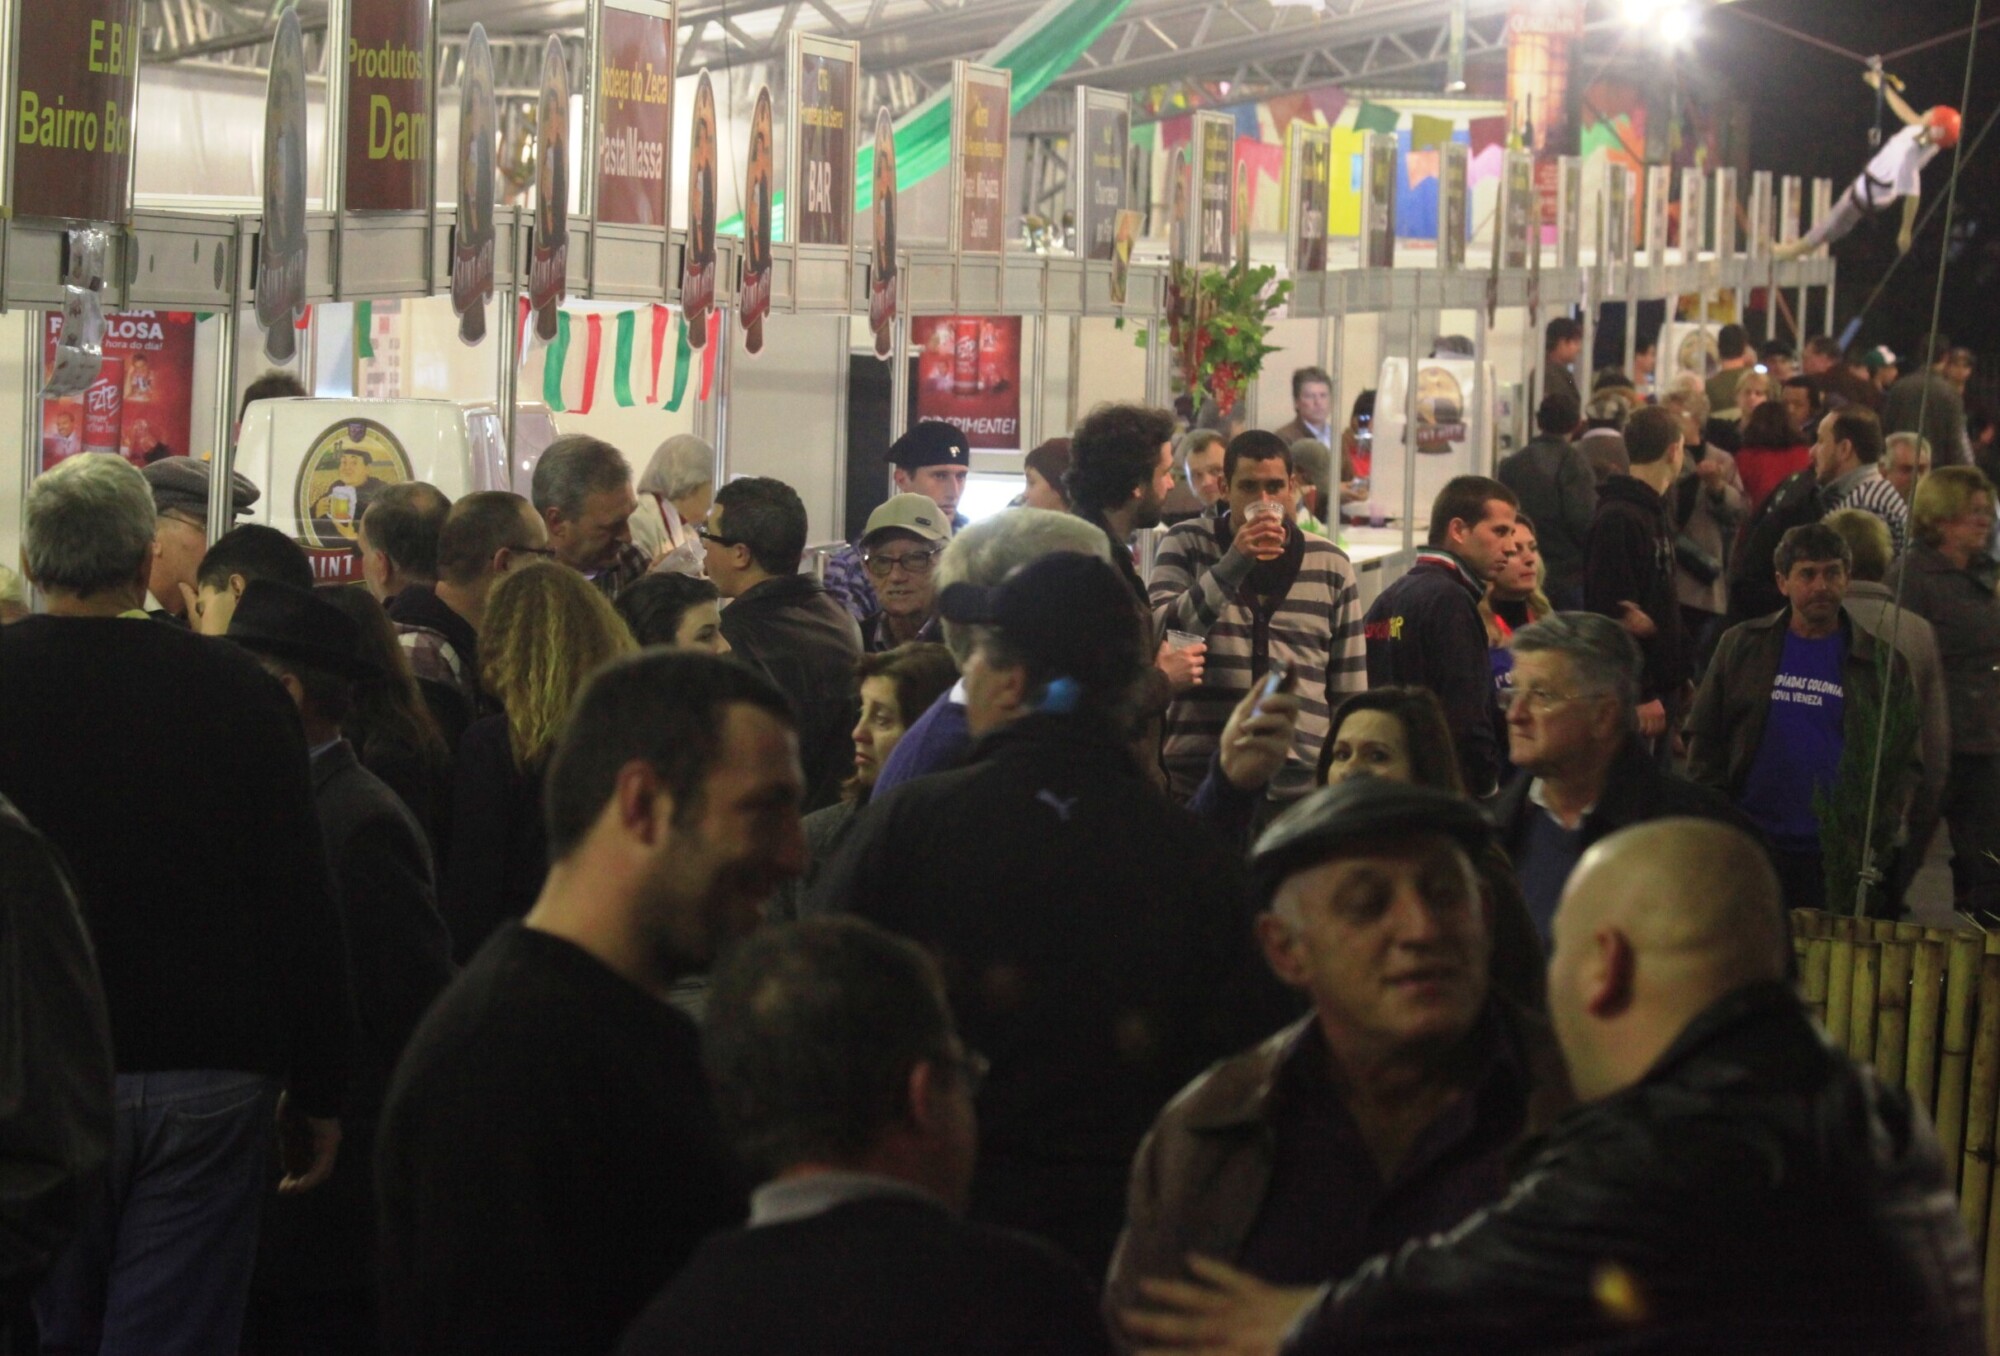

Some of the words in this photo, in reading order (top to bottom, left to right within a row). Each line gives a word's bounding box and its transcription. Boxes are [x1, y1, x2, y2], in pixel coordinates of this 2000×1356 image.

[349, 37, 423, 79] Produtos
[631, 61, 643, 101] do
[644, 63, 668, 104] Zeca
[19, 90, 98, 152] Bairro
[808, 160, 832, 213] BAR
[130, 341, 142, 350] do
[919, 415, 1016, 435] RIMENTE!
[1792, 692, 1823, 707] VENEZA
